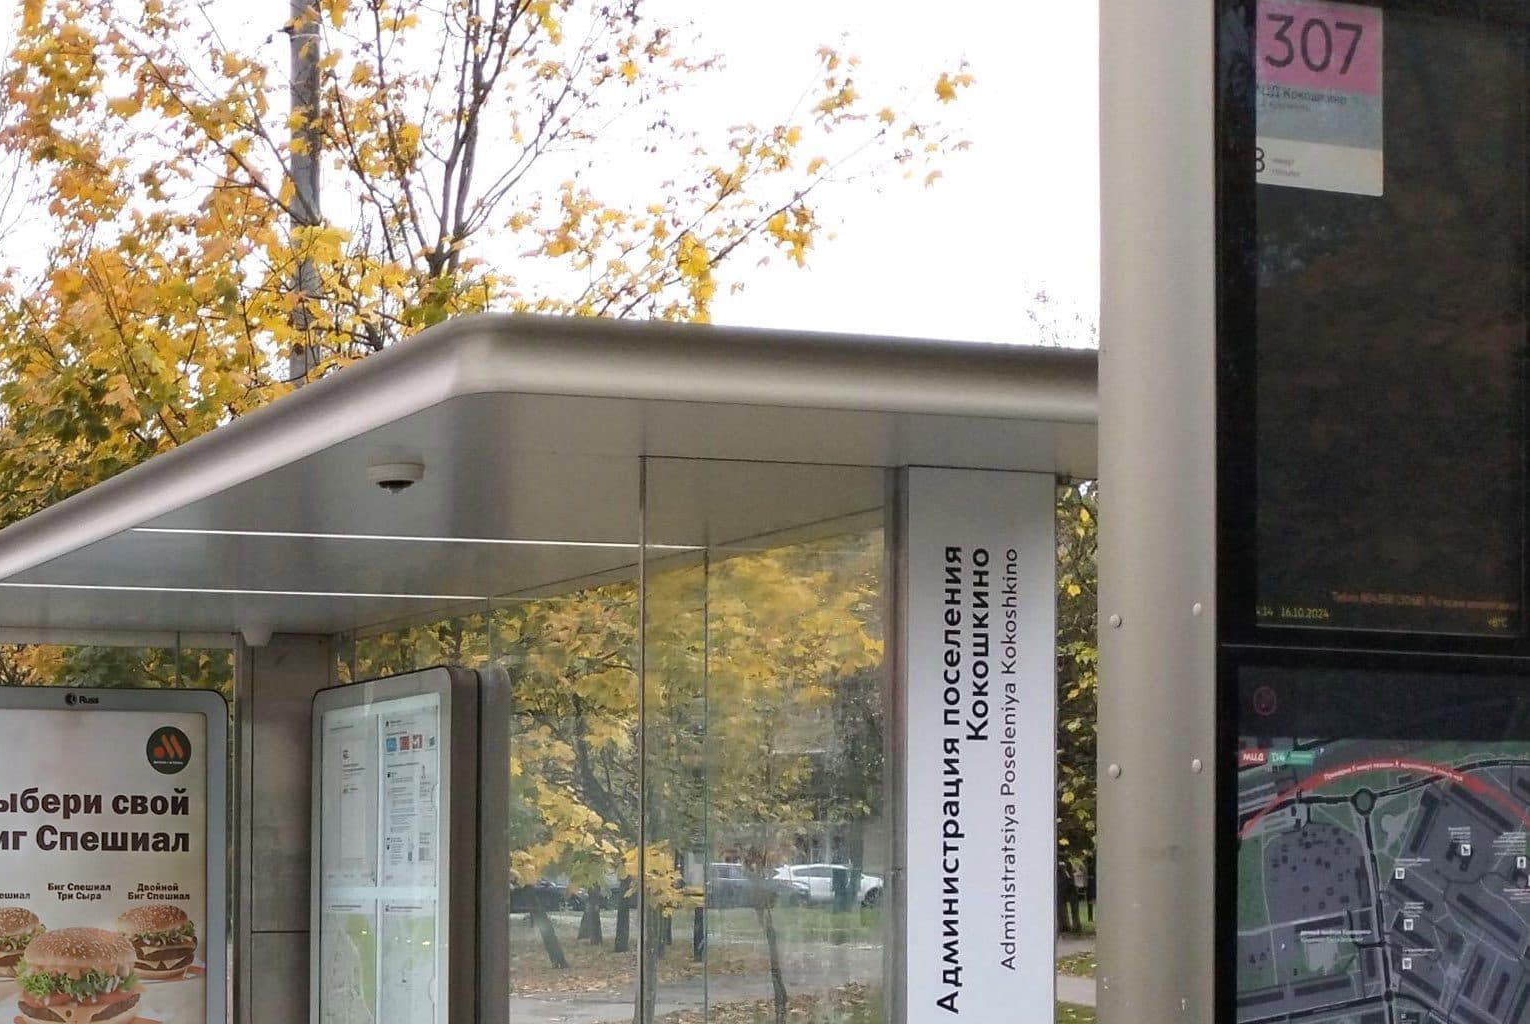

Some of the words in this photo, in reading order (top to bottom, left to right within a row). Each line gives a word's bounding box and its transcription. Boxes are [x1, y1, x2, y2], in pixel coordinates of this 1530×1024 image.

[1265, 14, 1363, 75] 307
[943, 546, 962, 726] поселения
[1000, 548, 1018, 675] Kokoshkino
[966, 548, 990, 741] Кокошкино
[1000, 682, 1020, 796] Poseleniya
[111, 787, 190, 816] свой
[36, 824, 190, 852] Спешиал
[47, 882, 65, 891] Биг
[67, 882, 111, 891] Спешиал
[57, 892, 73, 901] Три
[76, 891, 101, 901] Сыра
[128, 892, 144, 900] Биг
[146, 891, 190, 901] Спешиал
[137, 882, 179, 892] Двойной
[937, 738, 964, 1014] Администрация
[1000, 803, 1019, 971] Administratsiya
